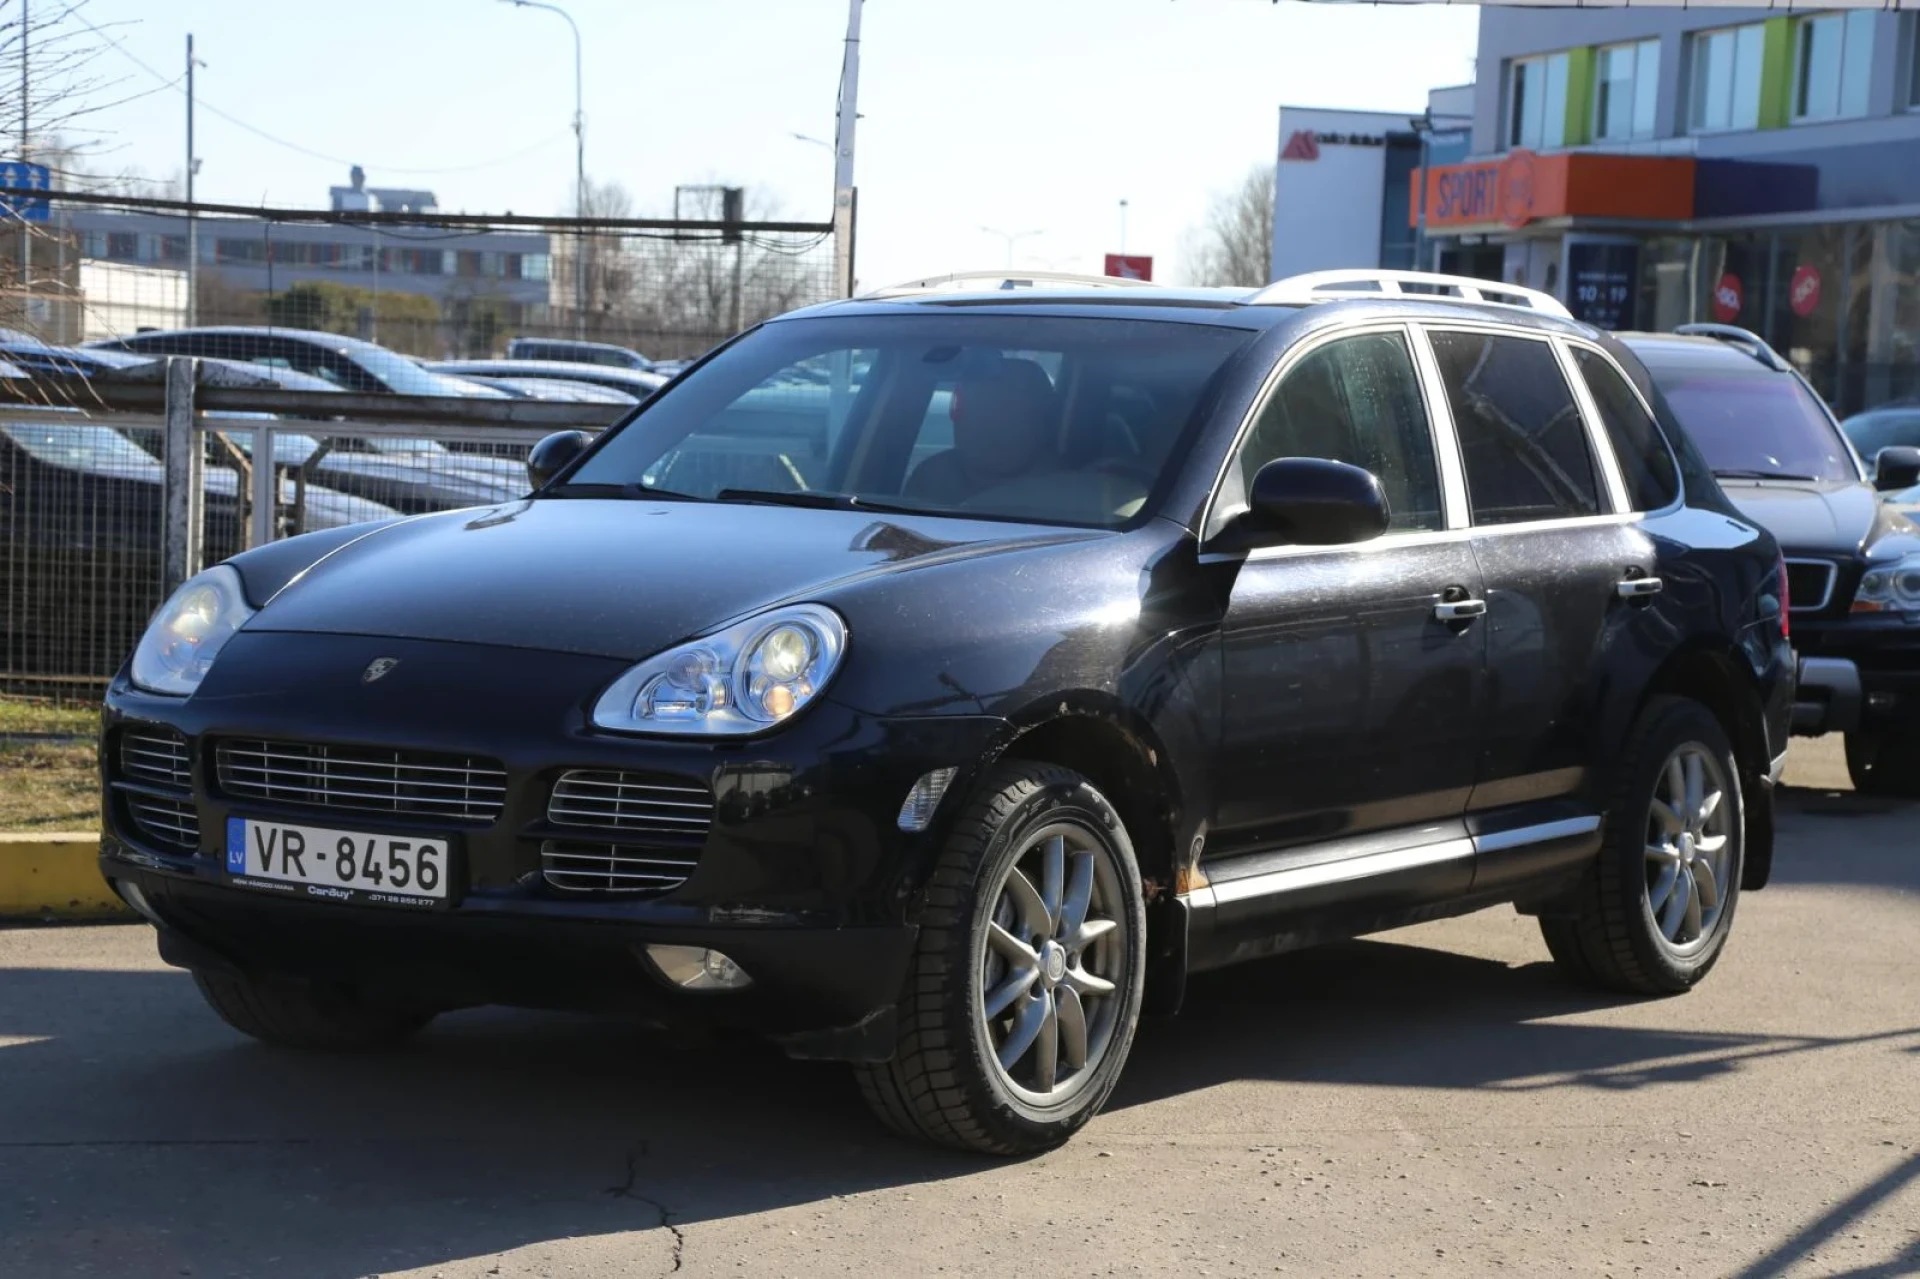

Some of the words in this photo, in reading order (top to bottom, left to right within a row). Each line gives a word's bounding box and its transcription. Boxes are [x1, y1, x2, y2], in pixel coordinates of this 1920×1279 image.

[1436, 168, 1498, 218] SPORT
[229, 852, 243, 864] LV
[254, 826, 439, 890] VR-8456
